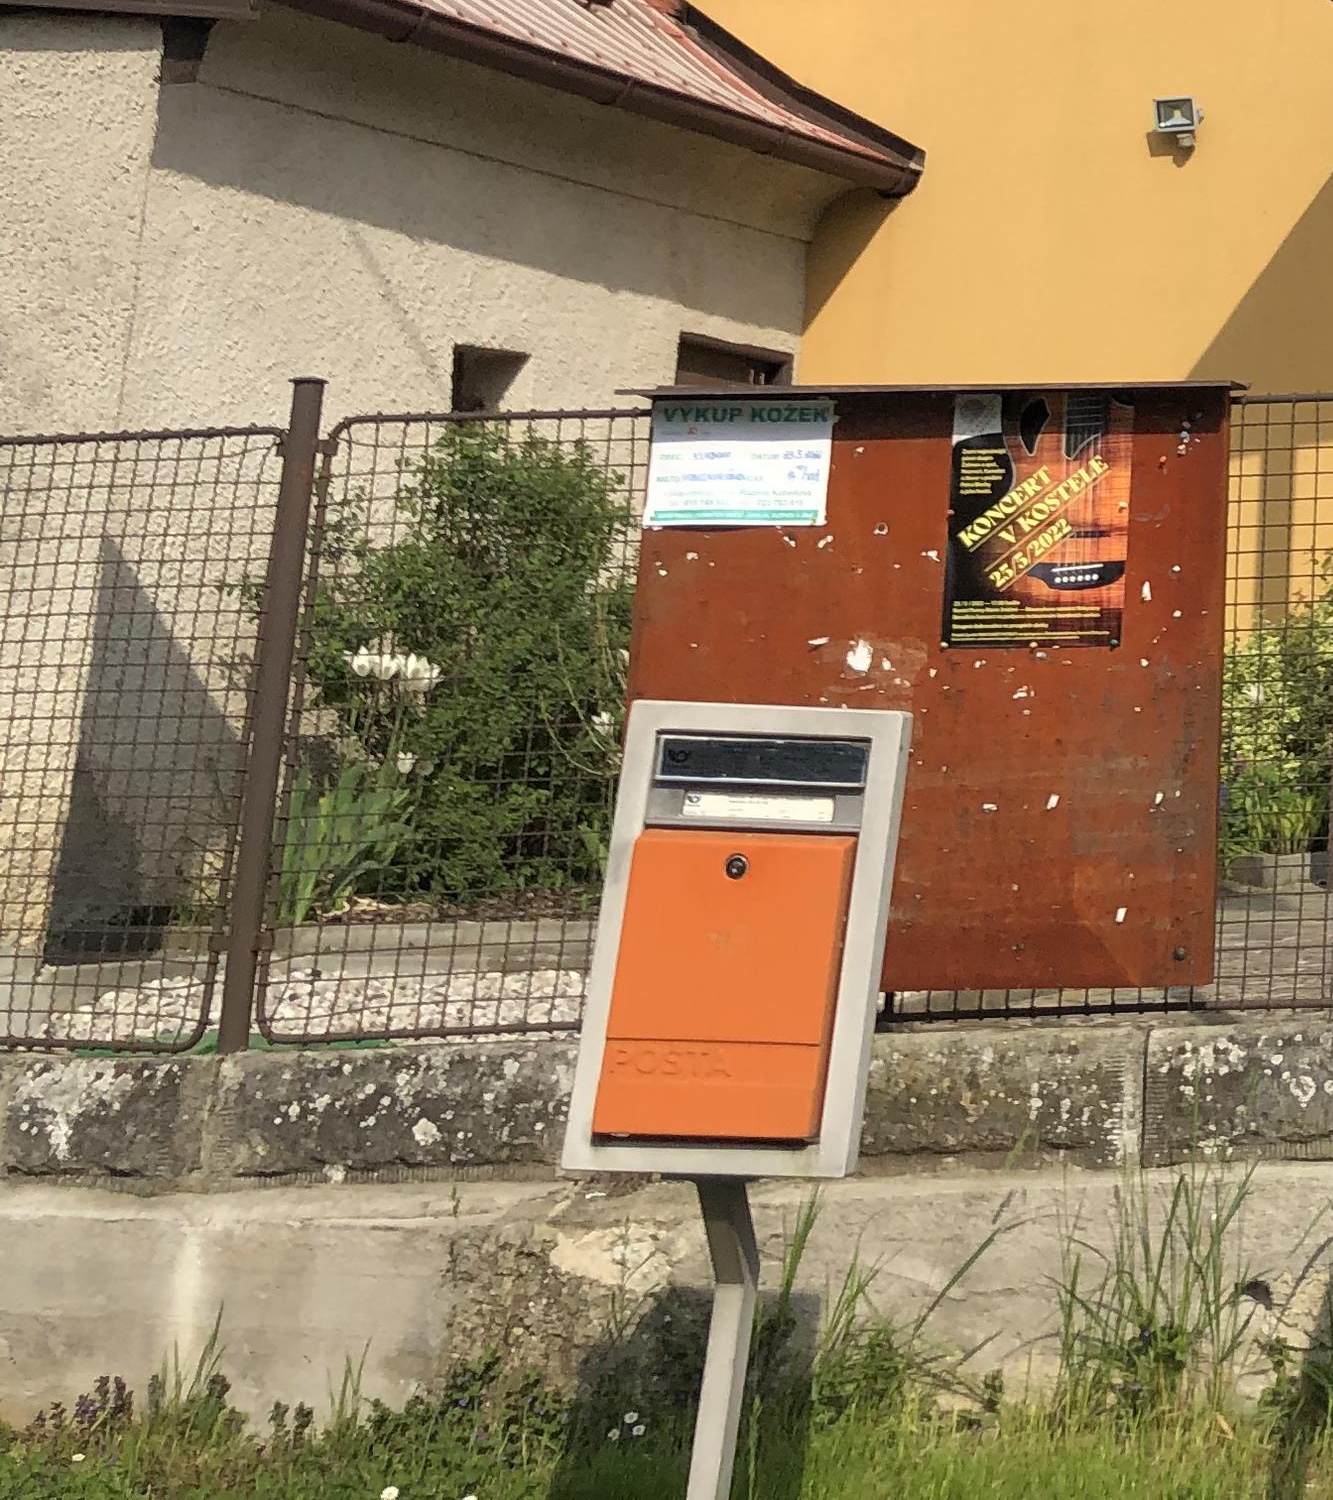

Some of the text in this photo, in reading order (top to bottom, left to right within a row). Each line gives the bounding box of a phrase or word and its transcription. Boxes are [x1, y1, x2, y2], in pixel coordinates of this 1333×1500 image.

[663, 404, 829, 423] VYKUP KOŽEK
[957, 465, 1052, 548] KONCERT
[998, 525, 1017, 544] V
[1016, 455, 1110, 533] KOSTELE
[988, 518, 1073, 588] 25/5/2022
